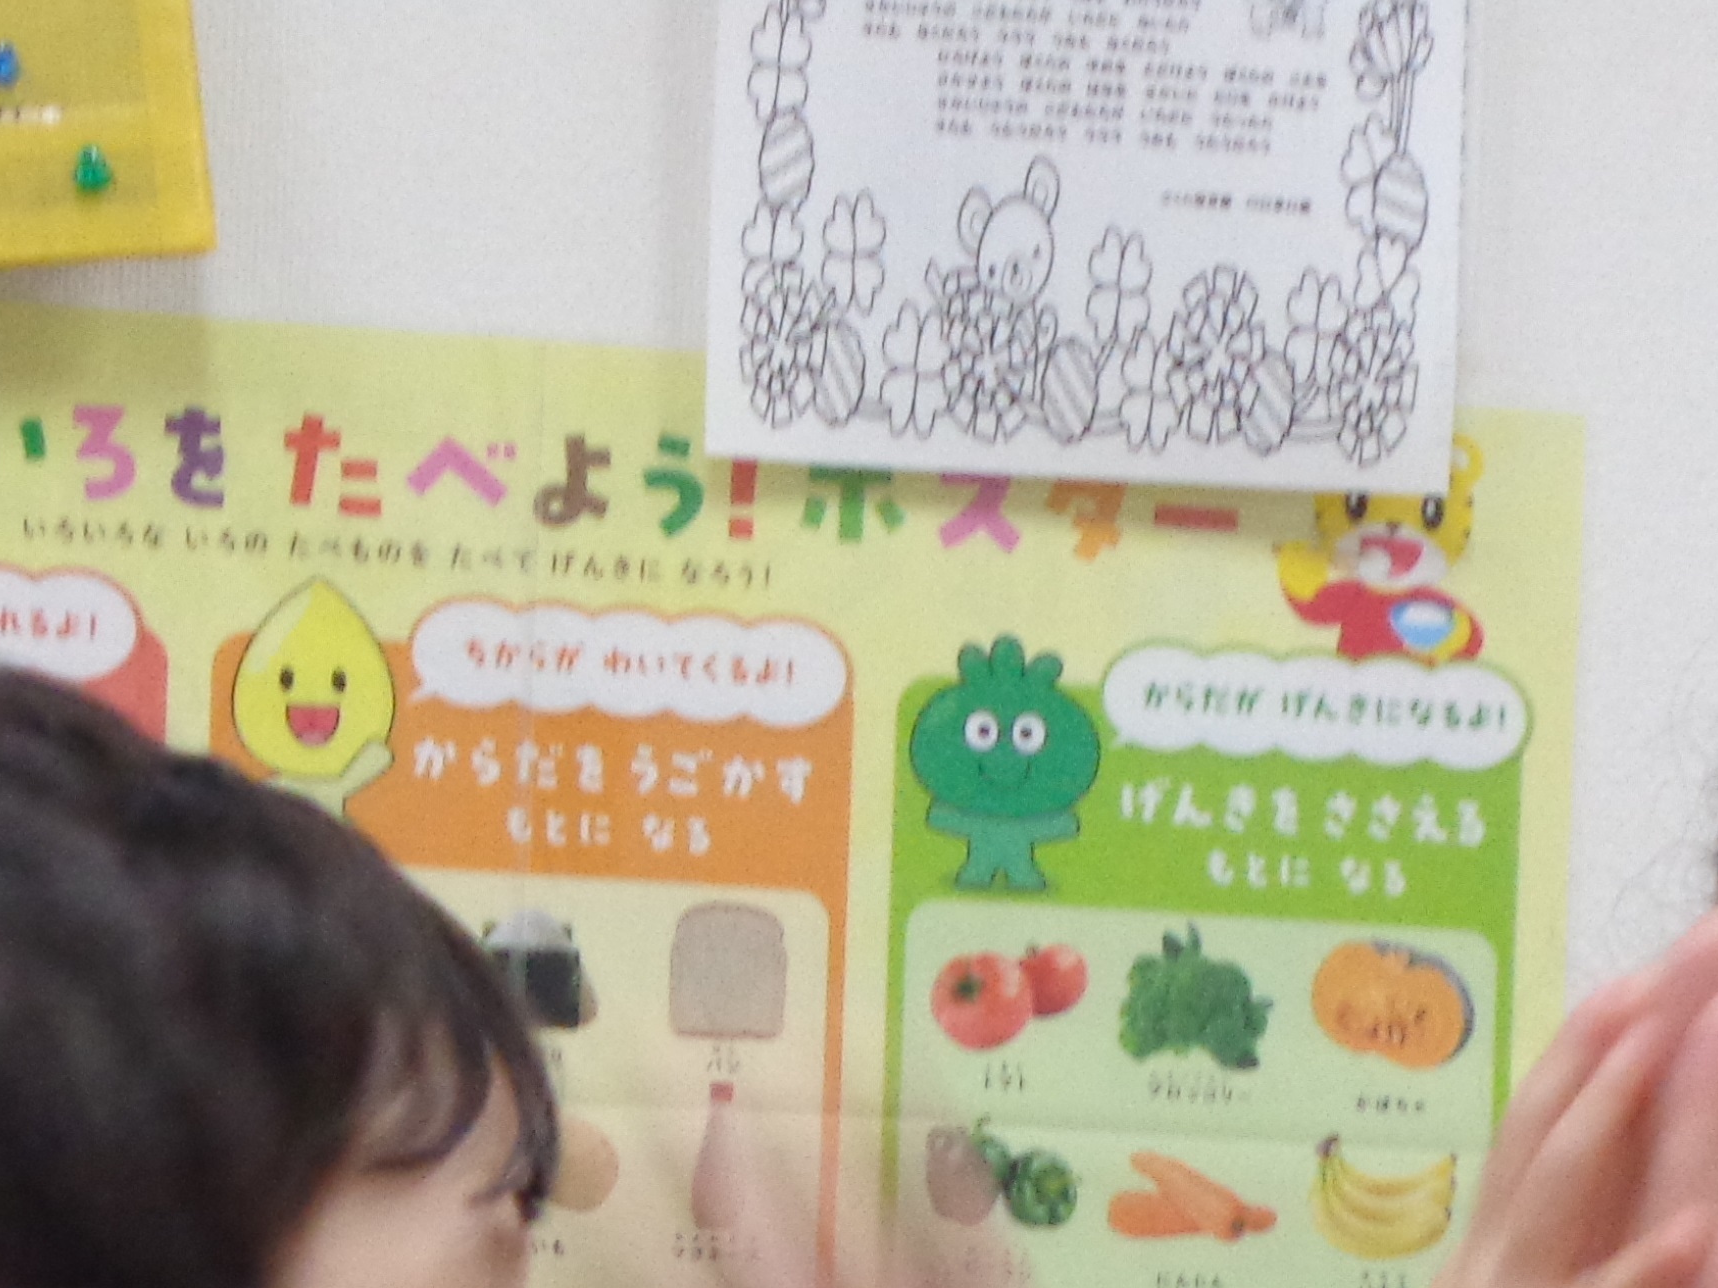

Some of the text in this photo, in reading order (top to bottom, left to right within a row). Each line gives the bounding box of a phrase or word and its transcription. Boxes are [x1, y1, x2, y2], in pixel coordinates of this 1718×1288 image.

[413, 734, 813, 805] からだを うごかす
[506, 805, 711, 856] もとに なる
[1120, 777, 1487, 849] げんきを ささえる
[1207, 848, 1407, 898] もとに なる
